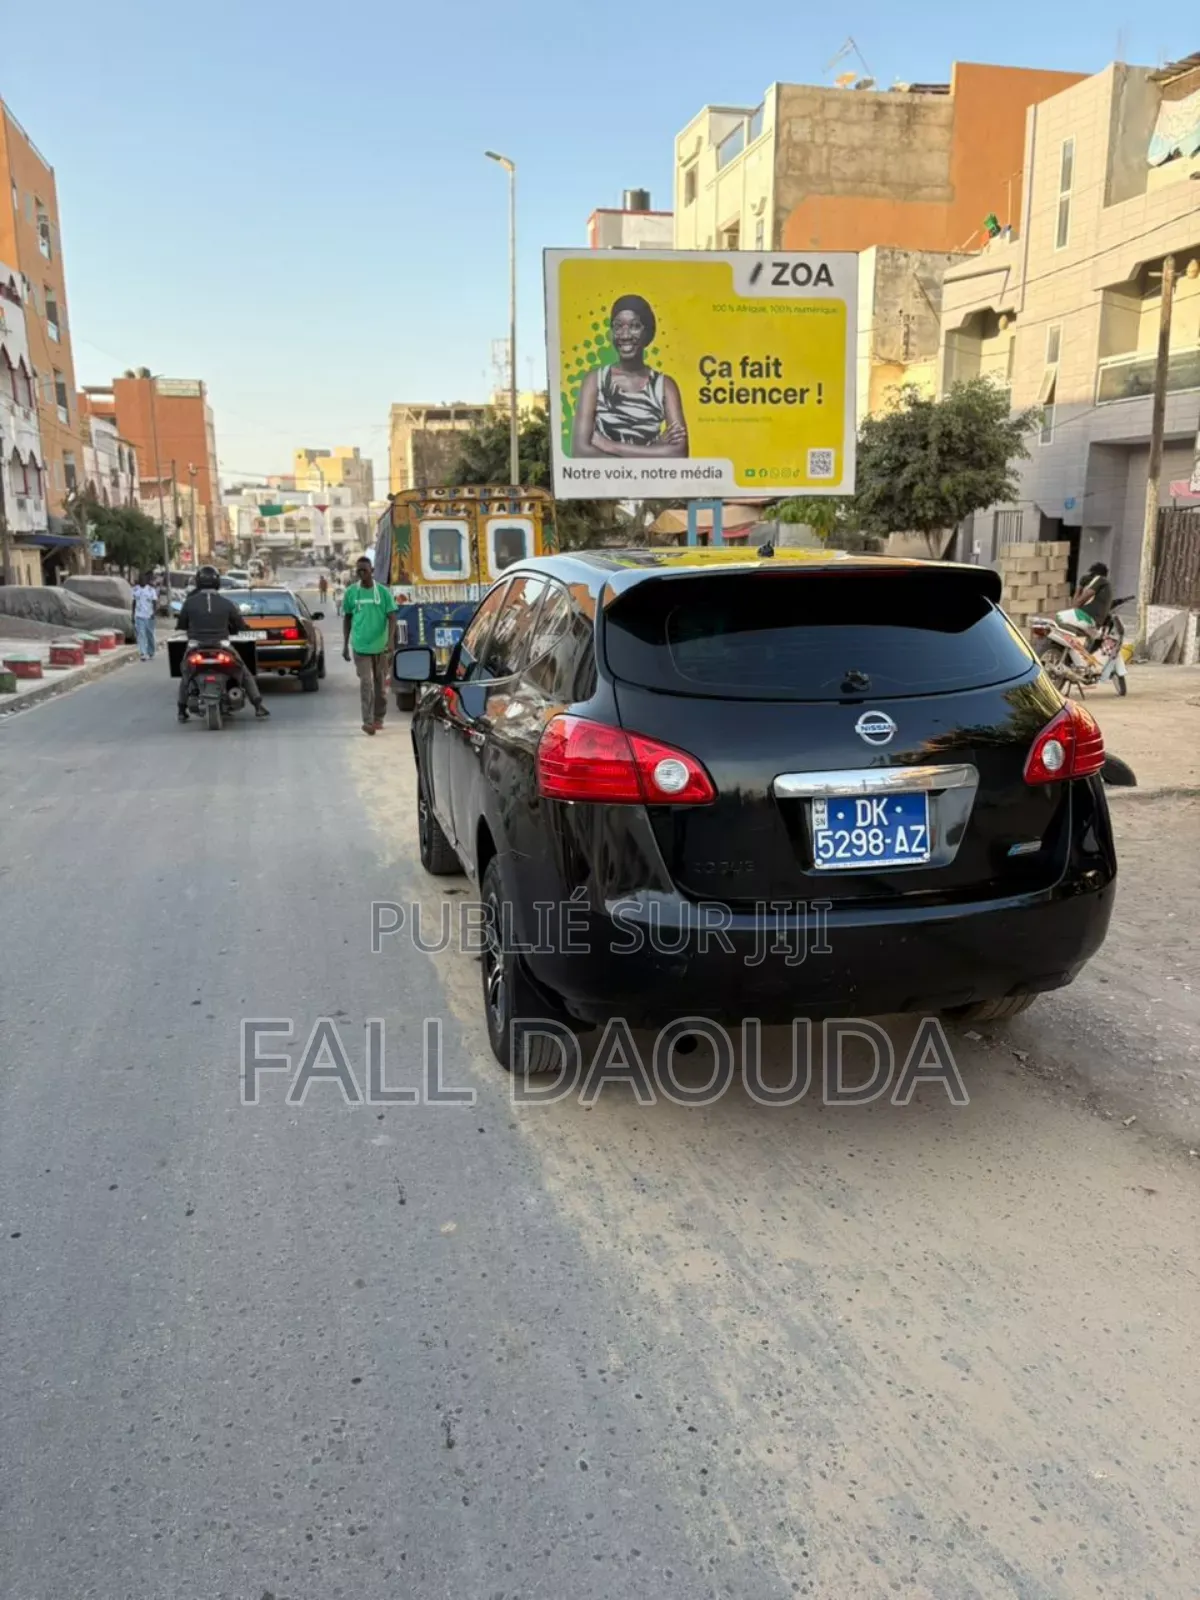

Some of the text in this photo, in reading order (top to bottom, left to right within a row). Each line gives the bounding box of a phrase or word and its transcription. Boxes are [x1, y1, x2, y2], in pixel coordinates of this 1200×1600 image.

[771, 262, 834, 287] ZOA
[699, 355, 782, 385] Ça fait
[699, 381, 824, 405] sciencer !
[562, 466, 723, 480] Notre voix, notre média
[855, 798, 889, 828] DK
[817, 825, 927, 859] 5298-AZ
